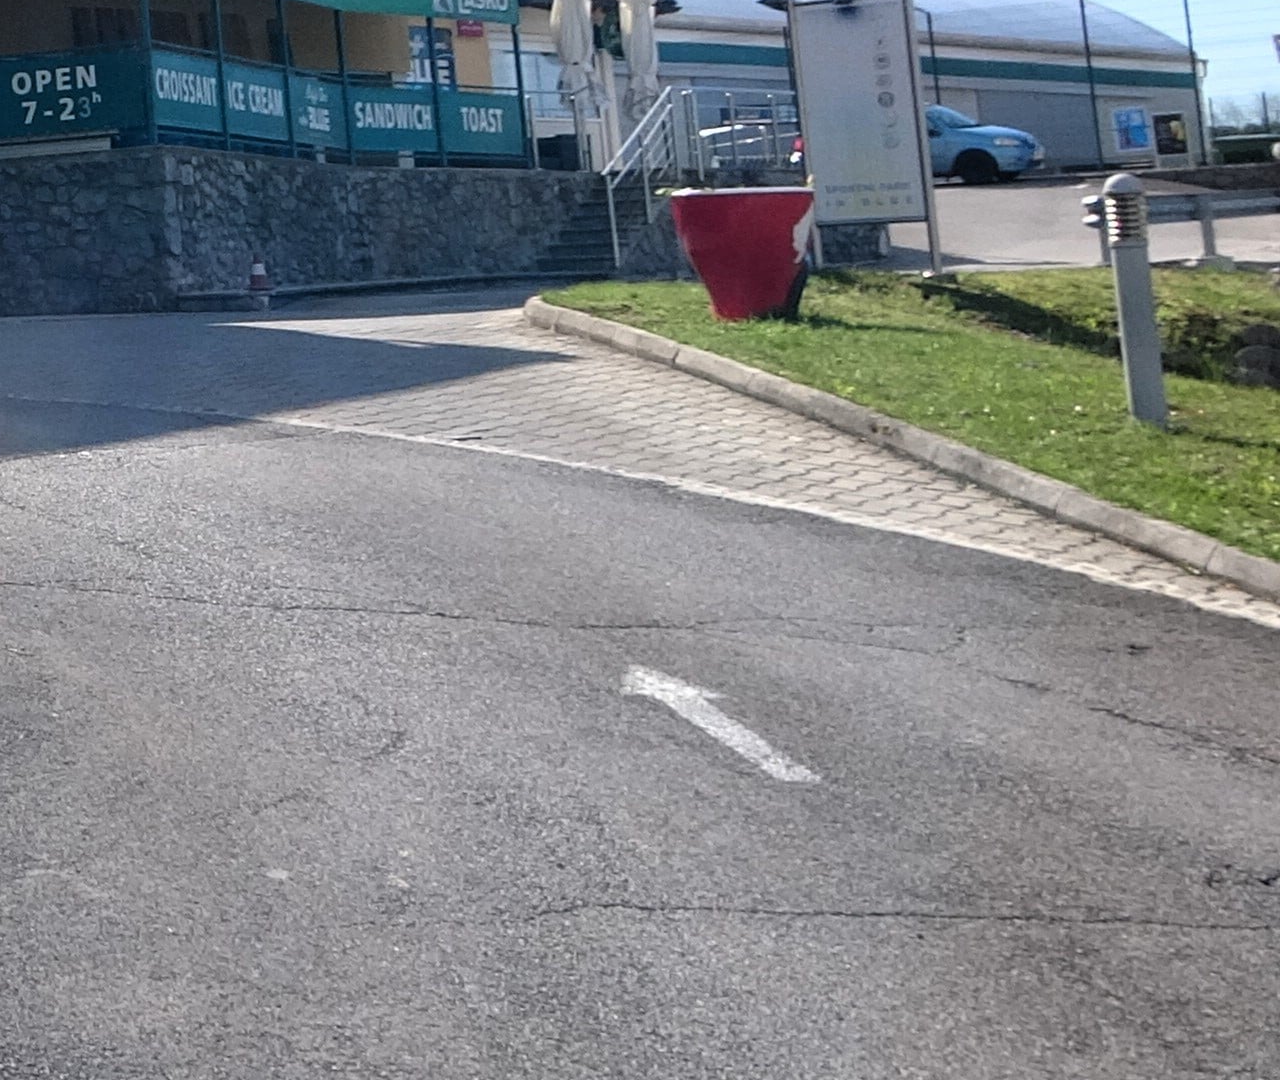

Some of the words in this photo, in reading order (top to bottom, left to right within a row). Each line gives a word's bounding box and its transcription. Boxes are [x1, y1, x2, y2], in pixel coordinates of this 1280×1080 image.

[11, 65, 97, 95] OPEN
[155, 68, 217, 107] CROISSANT
[227, 80, 246, 112] ICE
[248, 84, 285, 117] CREAM
[354, 101, 433, 131] SANDWICH
[460, 107, 504, 133] TOAST
